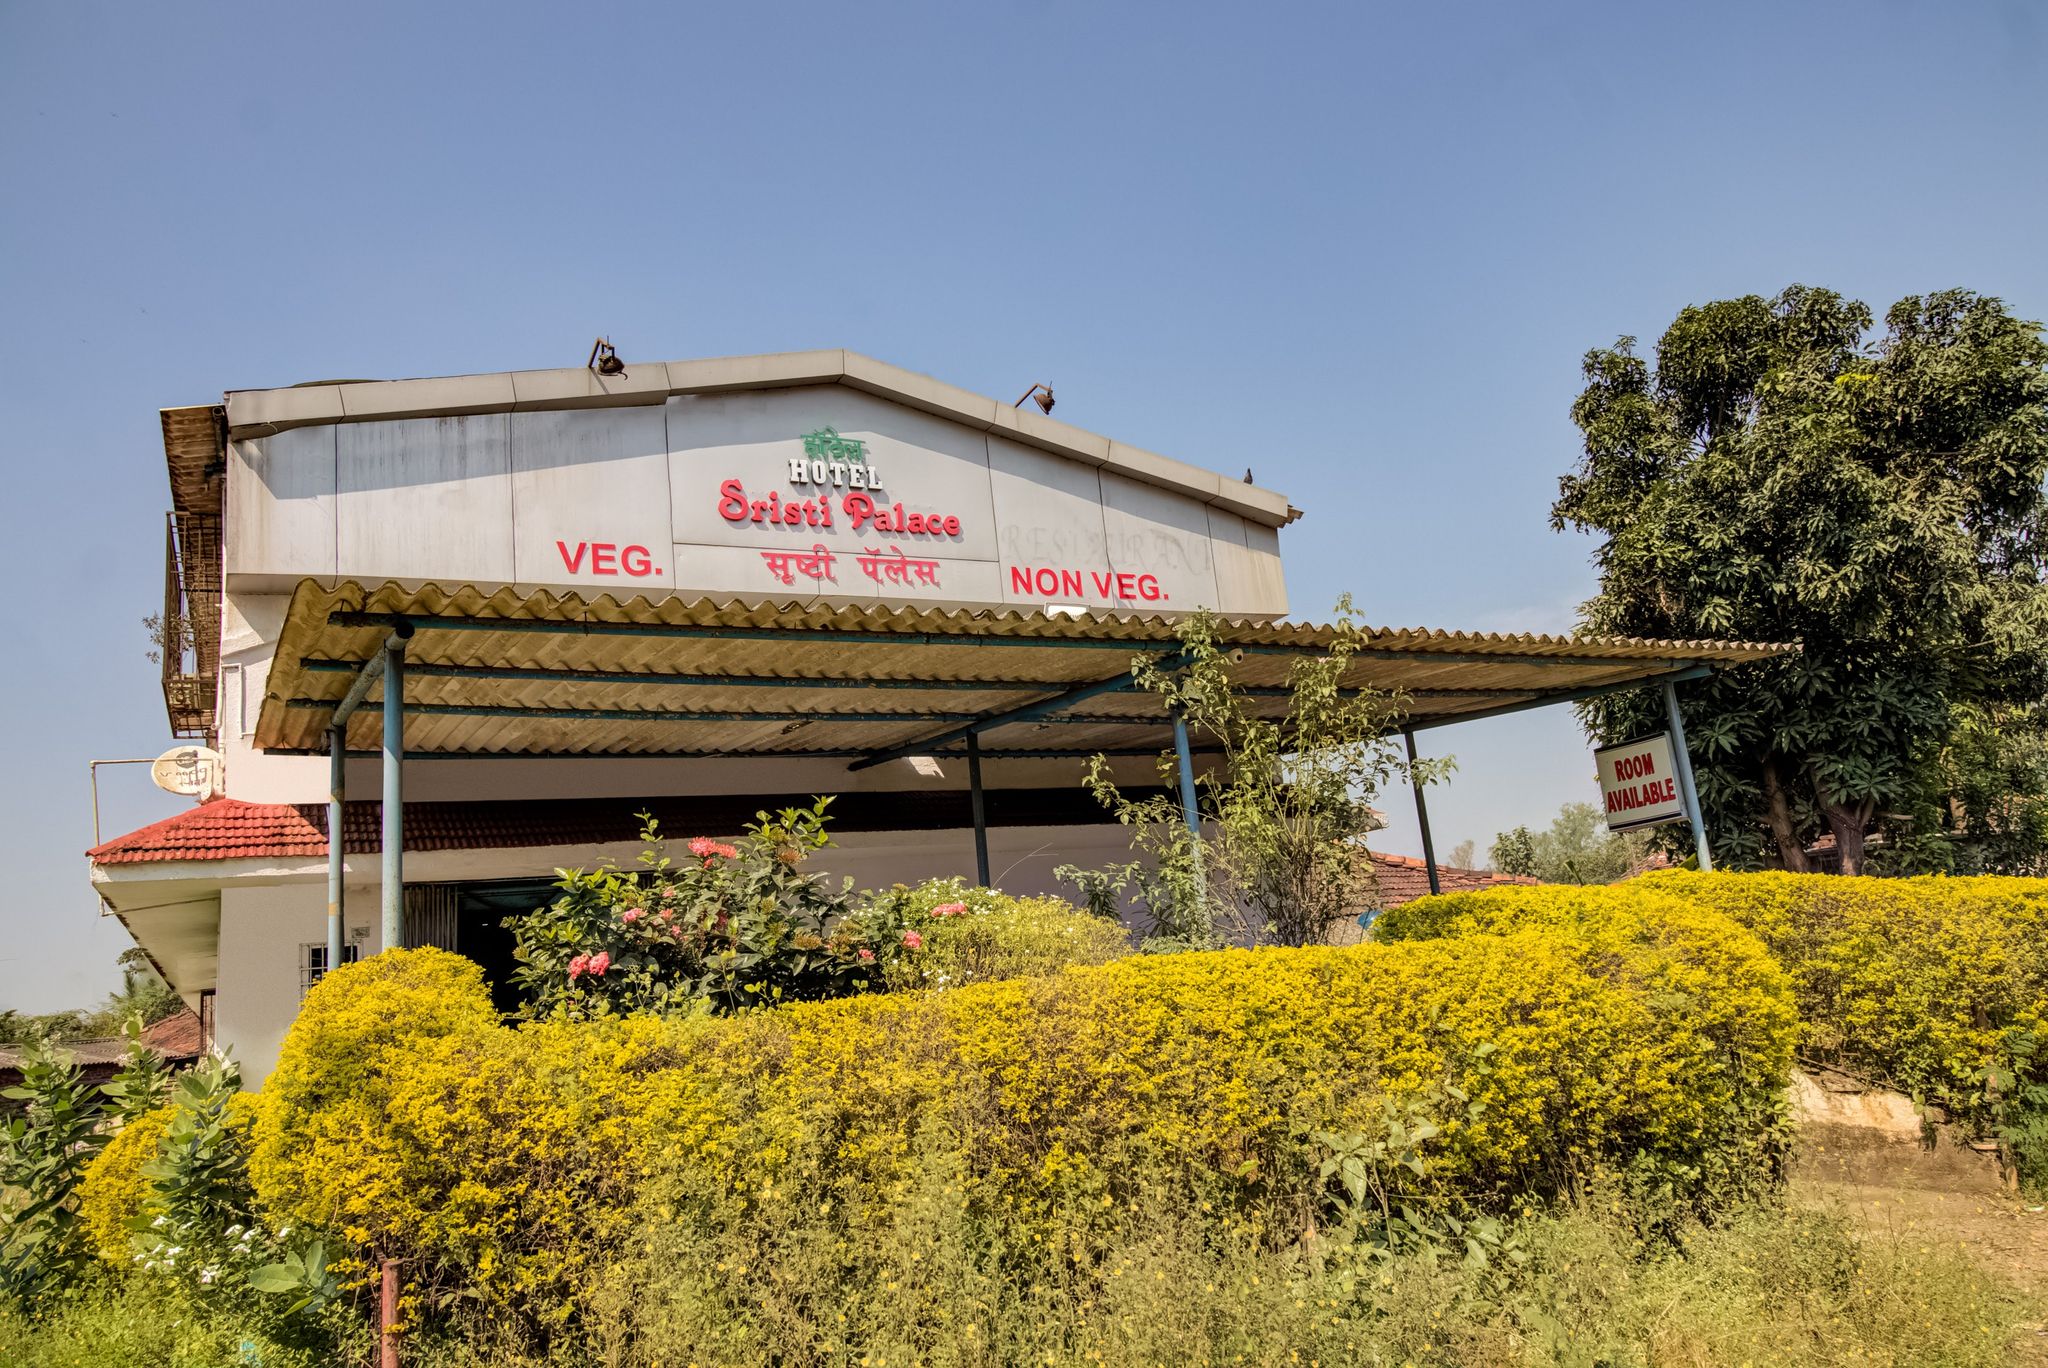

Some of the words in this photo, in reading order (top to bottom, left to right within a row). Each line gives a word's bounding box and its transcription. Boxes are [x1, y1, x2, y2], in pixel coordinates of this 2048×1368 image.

[789, 459, 883, 491] HOTEL
[718, 478, 834, 528] Sristi
[842, 491, 961, 537] Palace
[556, 540, 664, 577] VEG.
[1010, 566, 1084, 597] NON
[1091, 571, 1169, 601] VEG.
[1614, 752, 1655, 782] ROOM
[1607, 777, 1676, 814] AVAILABLE
